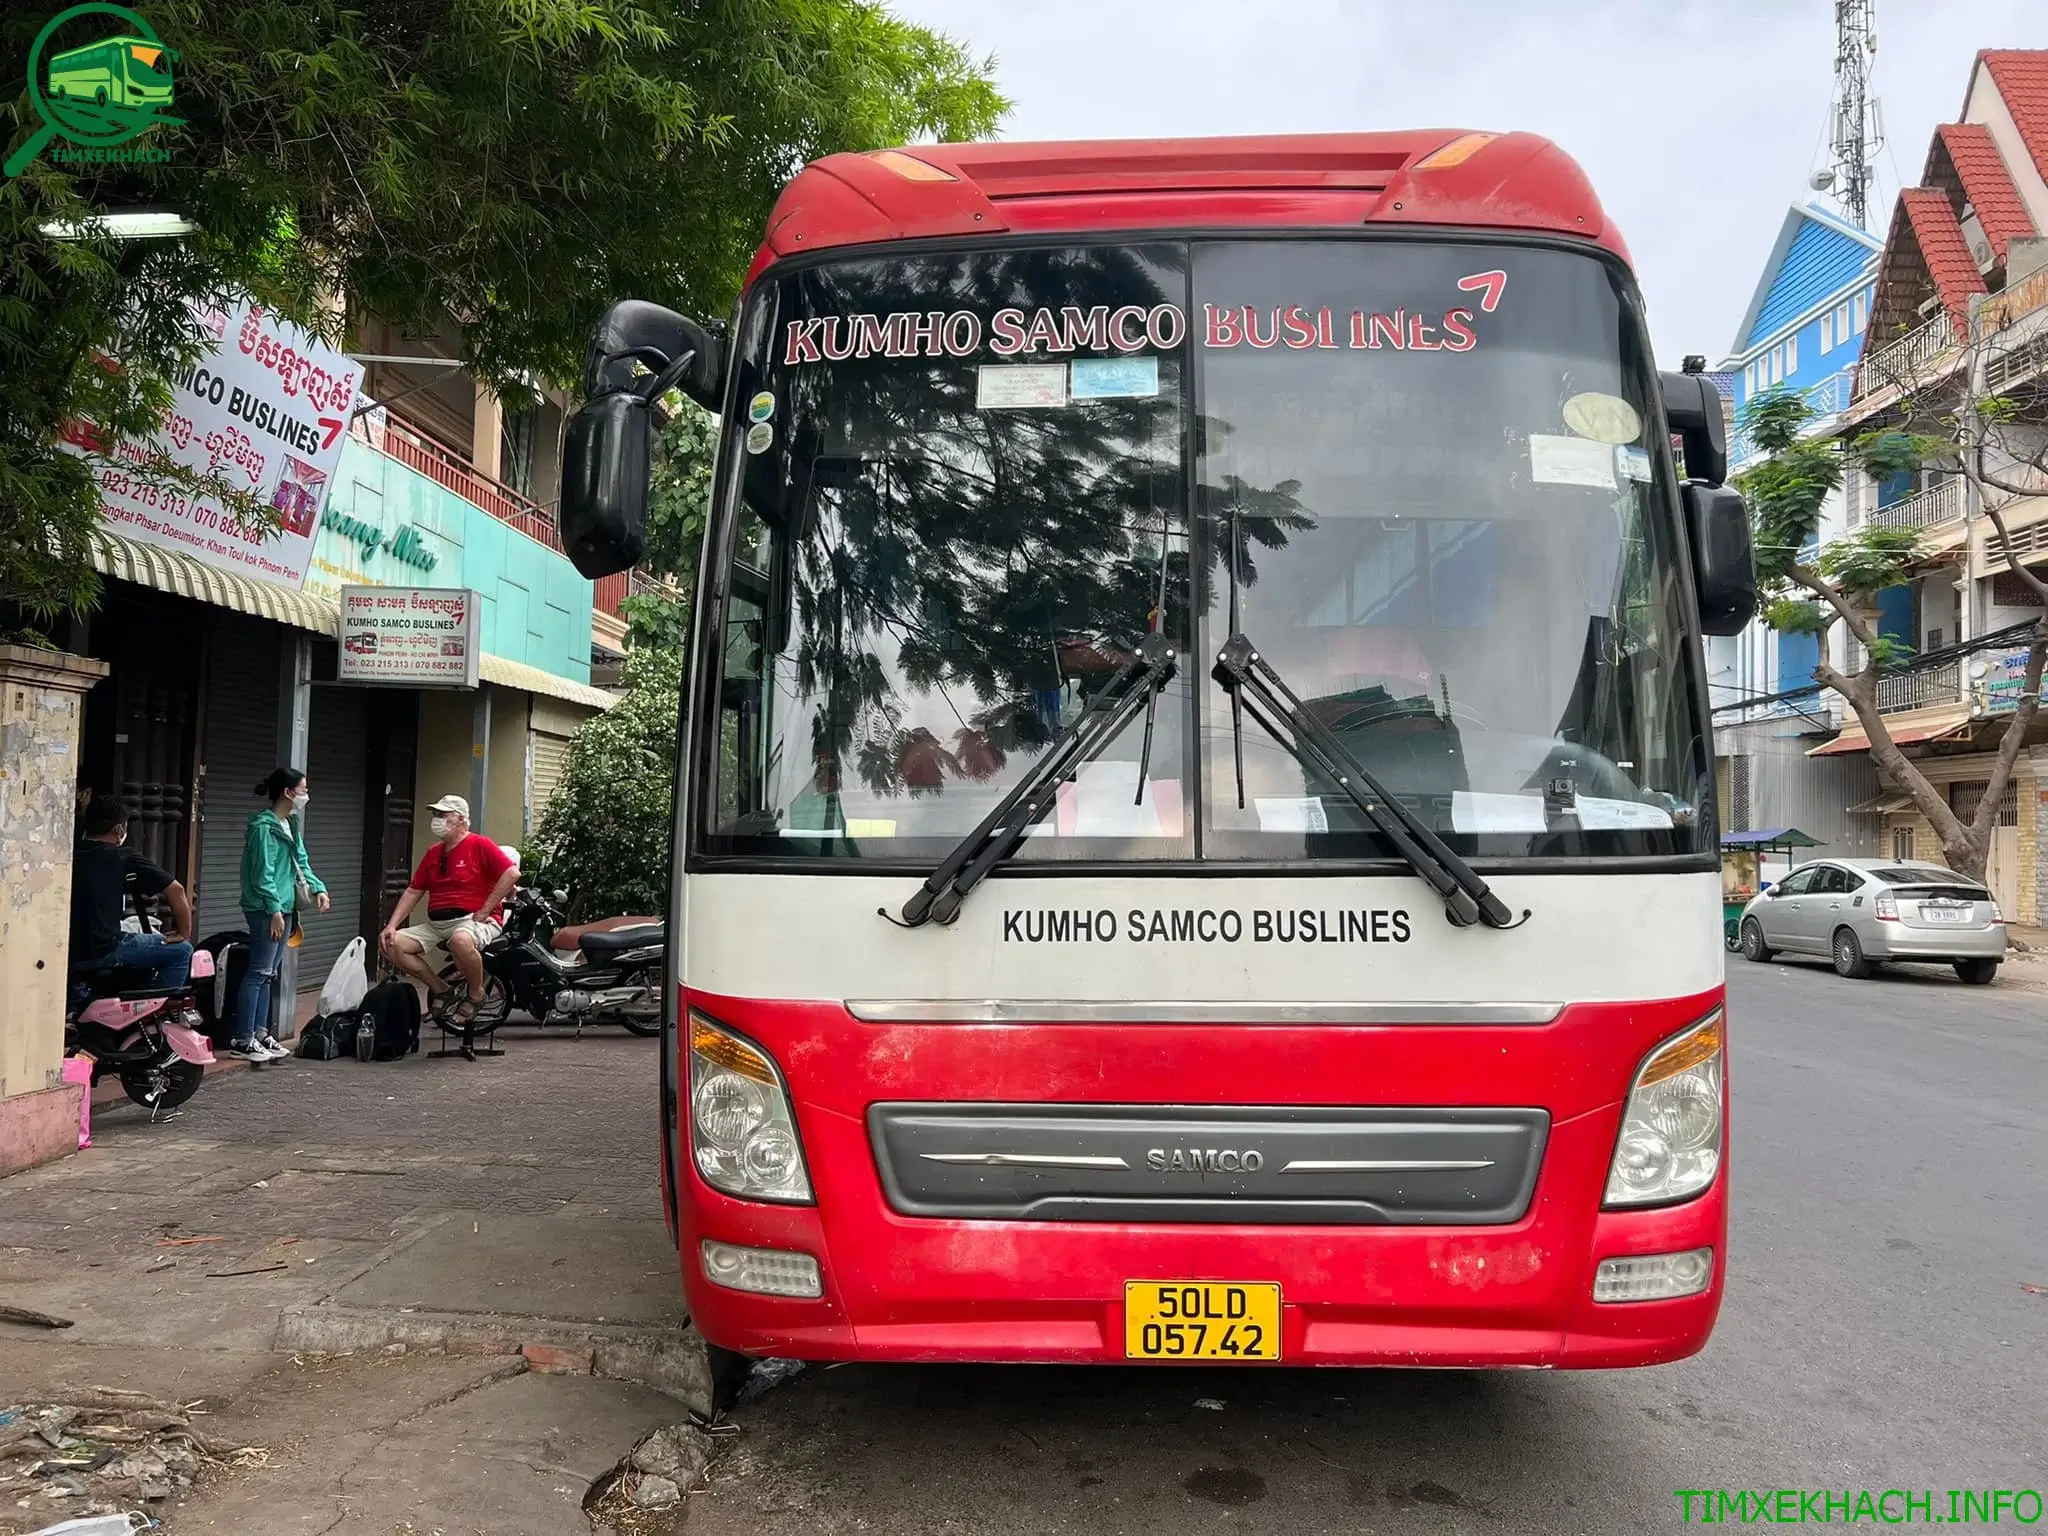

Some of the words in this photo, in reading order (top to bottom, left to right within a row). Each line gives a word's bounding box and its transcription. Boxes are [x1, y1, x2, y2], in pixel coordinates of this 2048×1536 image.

[784, 310, 982, 365] KUMHO
[989, 303, 1186, 355] SAMCO
[227, 386, 320, 456] BUSLINES
[101, 470, 130, 496] 023
[131, 482, 160, 507] 215
[160, 493, 186, 517] 313
[194, 506, 218, 529] 070
[219, 516, 240, 539] 882
[134, 513, 161, 534] Phsar
[162, 522, 205, 550] Doeumkor,
[206, 538, 227, 556] Khan
[228, 545, 245, 562] Toul
[244, 551, 257, 566] kok
[258, 557, 282, 576] Phnom
[282, 565, 300, 580] Penh
[347, 617, 379, 628] KUMHO
[380, 618, 411, 629] SAMCO
[413, 620, 455, 630] BUSLINES
[360, 660, 375, 668] 023
[377, 661, 393, 669] 215
[394, 661, 409, 669] 313
[415, 661, 430, 670] 070
[432, 662, 446, 670] 882
[449, 662, 464, 670] 882
[1002, 909, 1117, 942] KUMHO
[1127, 909, 1242, 943] SAMCO
[1253, 909, 1411, 943] BUSLINES
[1147, 1148, 1264, 1172] SAMCO
[1158, 1287, 1247, 1319] 50LD
[1142, 1323, 1263, 1356] 057.42
